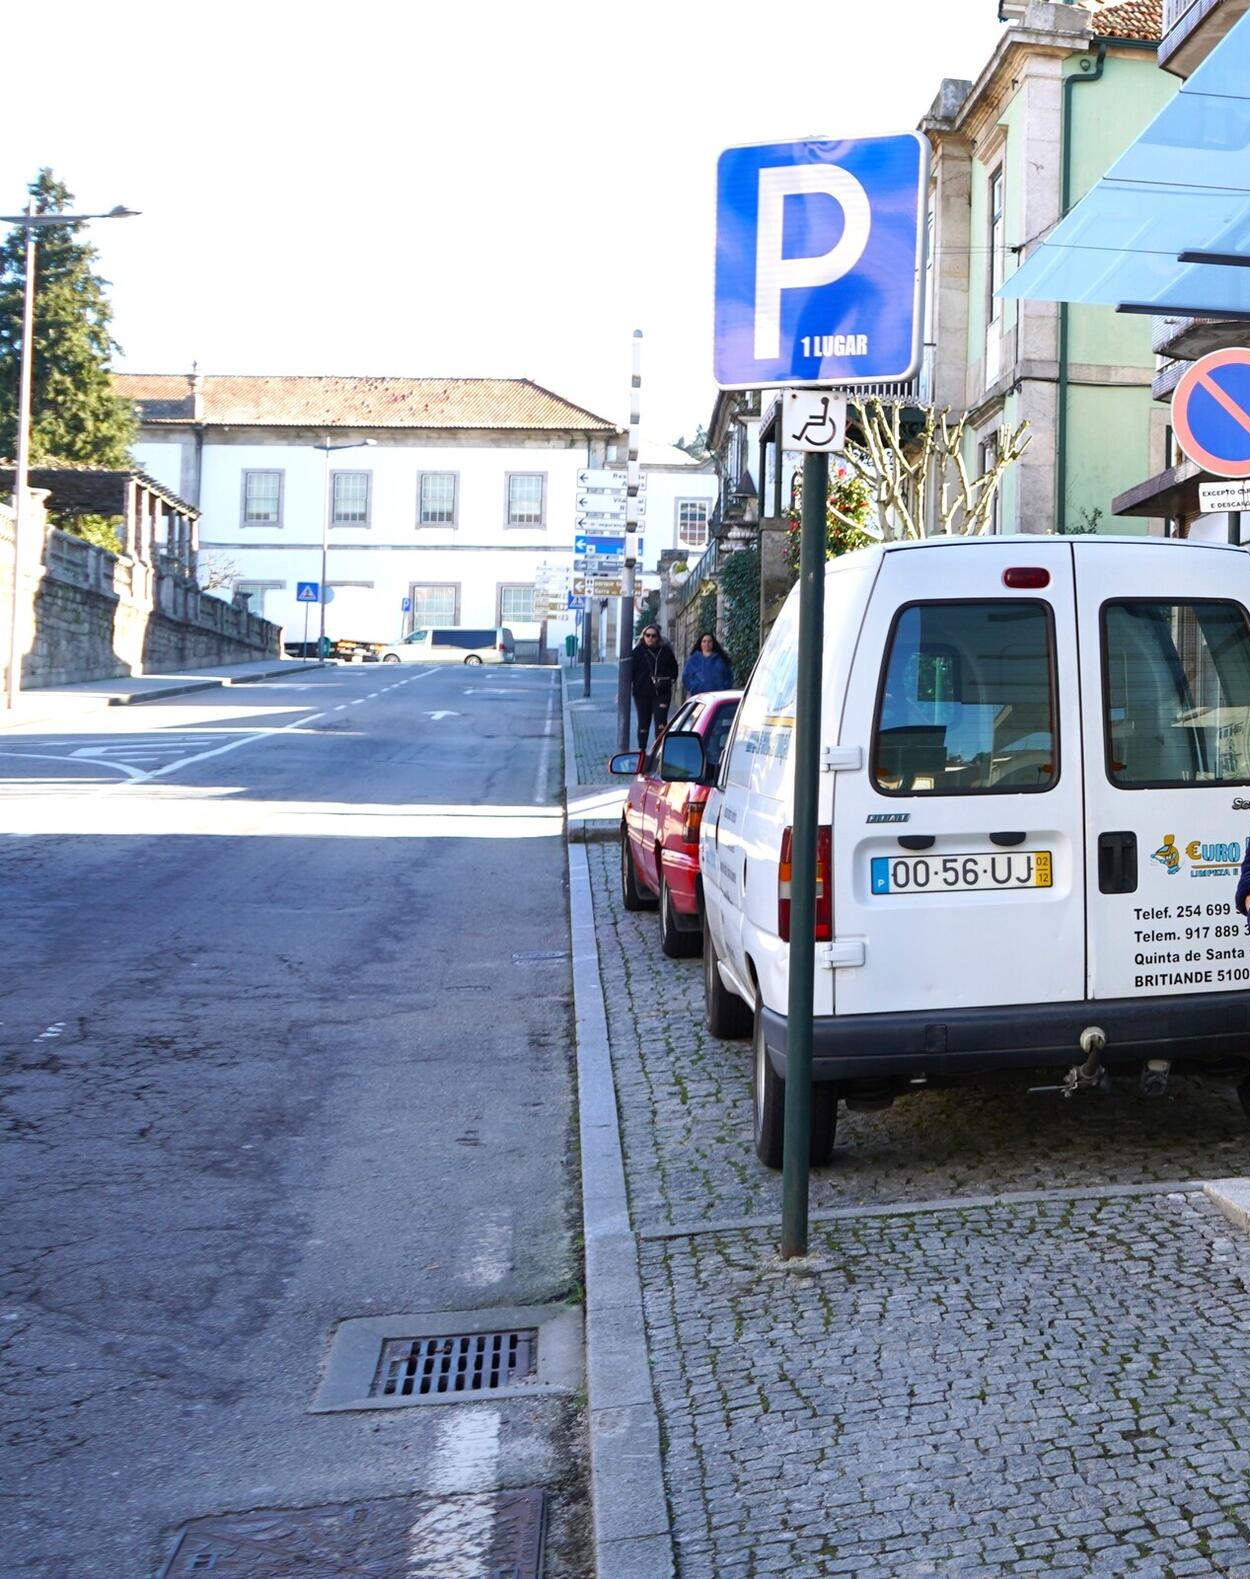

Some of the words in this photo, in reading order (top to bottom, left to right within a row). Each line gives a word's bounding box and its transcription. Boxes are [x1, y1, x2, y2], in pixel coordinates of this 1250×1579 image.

[753, 163, 871, 360] P
[801, 336, 811, 357] 1
[814, 334, 868, 357] LUGAR
[1202, 489, 1236, 497] EXCEPTO
[866, 813, 911, 824] FIAT
[1036, 856, 1048, 867] 02
[1038, 872, 1049, 883] 12
[1190, 868, 1231, 878] LIMPEZA
[877, 879, 885, 887] P
[1134, 906, 1172, 920] Telef.
[1176, 905, 1201, 918] 254
[1206, 903, 1231, 916] 699
[1134, 930, 1181, 943] Telem.
[1185, 927, 1210, 940] 917
[1215, 925, 1239, 938] 889
[1134, 952, 1180, 966] Quinta
[1185, 950, 1201, 962] de
[1206, 948, 1245, 960] Santa
[1135, 971, 1213, 987] BRITIANDE
[1217, 968, 1250, 982] 5100
